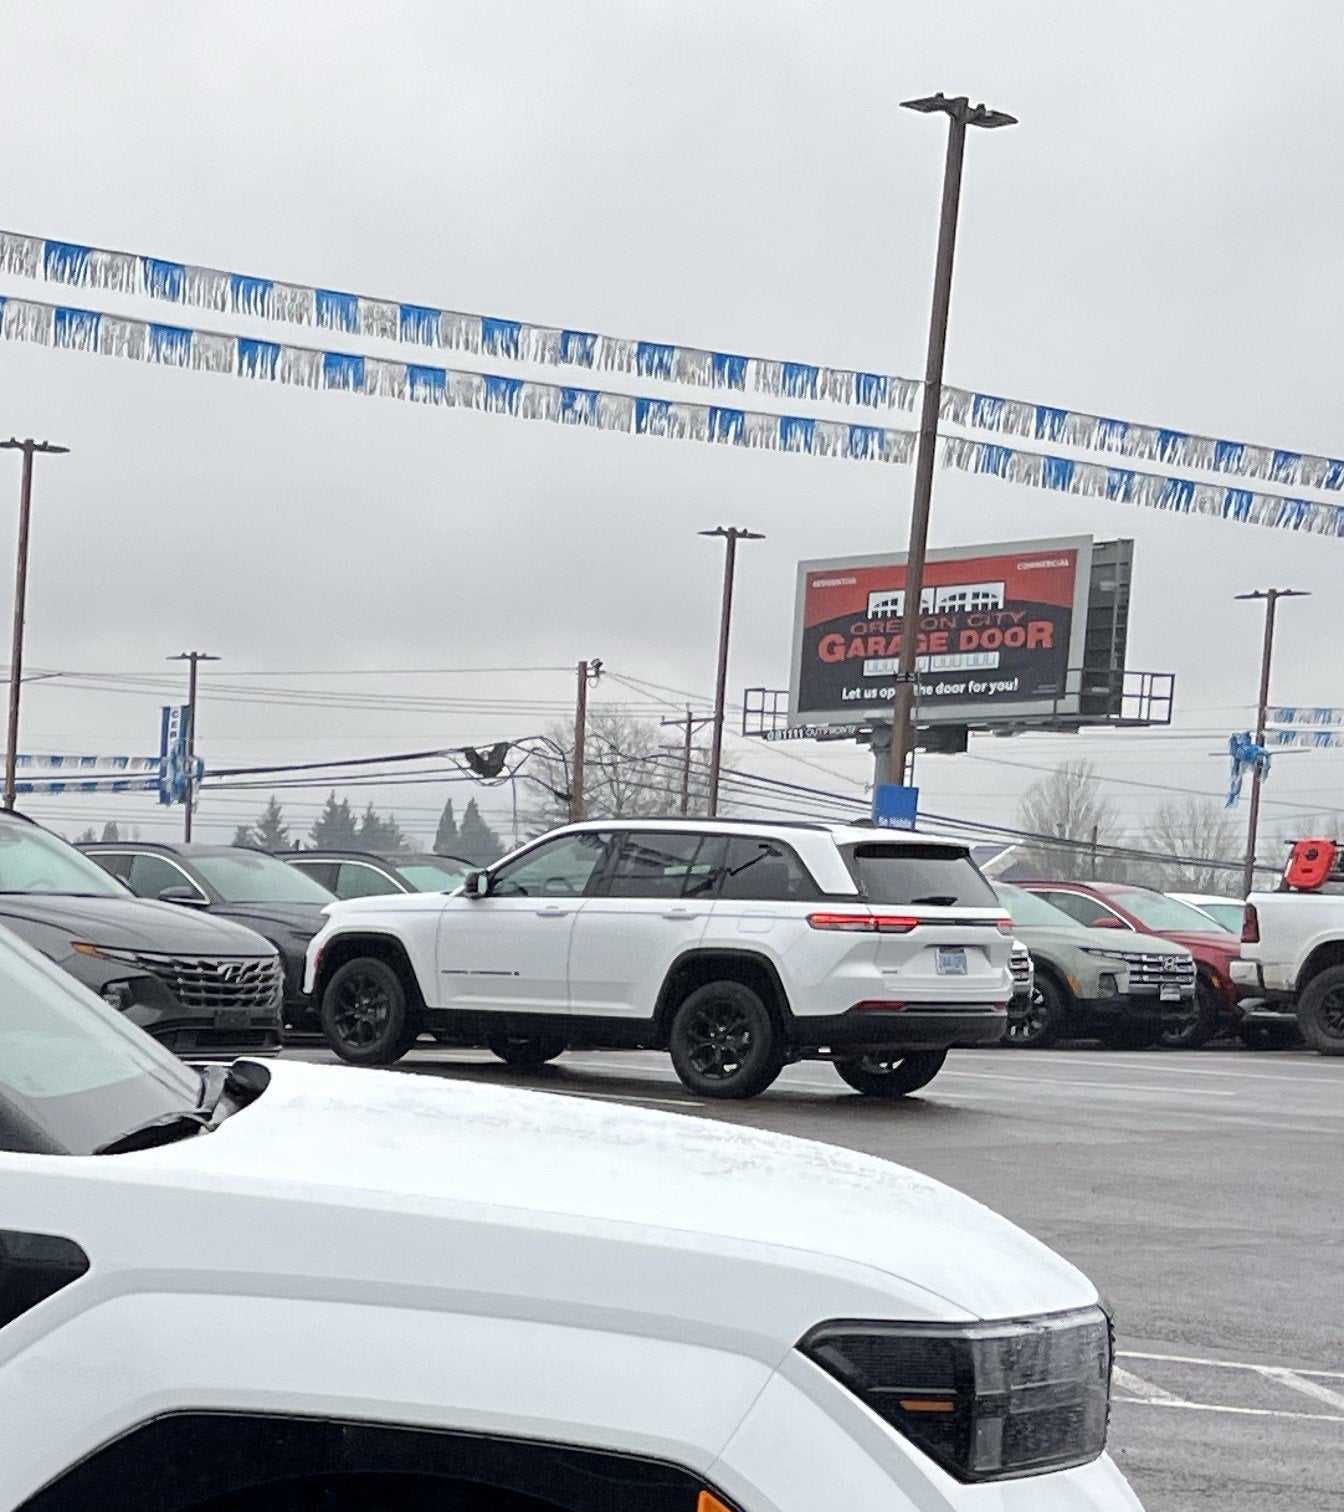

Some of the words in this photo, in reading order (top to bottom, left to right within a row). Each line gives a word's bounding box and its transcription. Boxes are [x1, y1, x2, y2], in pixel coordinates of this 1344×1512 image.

[850, 615, 957, 635] OREON
[967, 611, 1026, 627] CITY
[960, 620, 1054, 651] DOOR
[841, 687, 861, 700] Let
[864, 687, 877, 698] us
[935, 681, 966, 694] door
[967, 680, 987, 694] for
[988, 677, 1019, 695] you!
